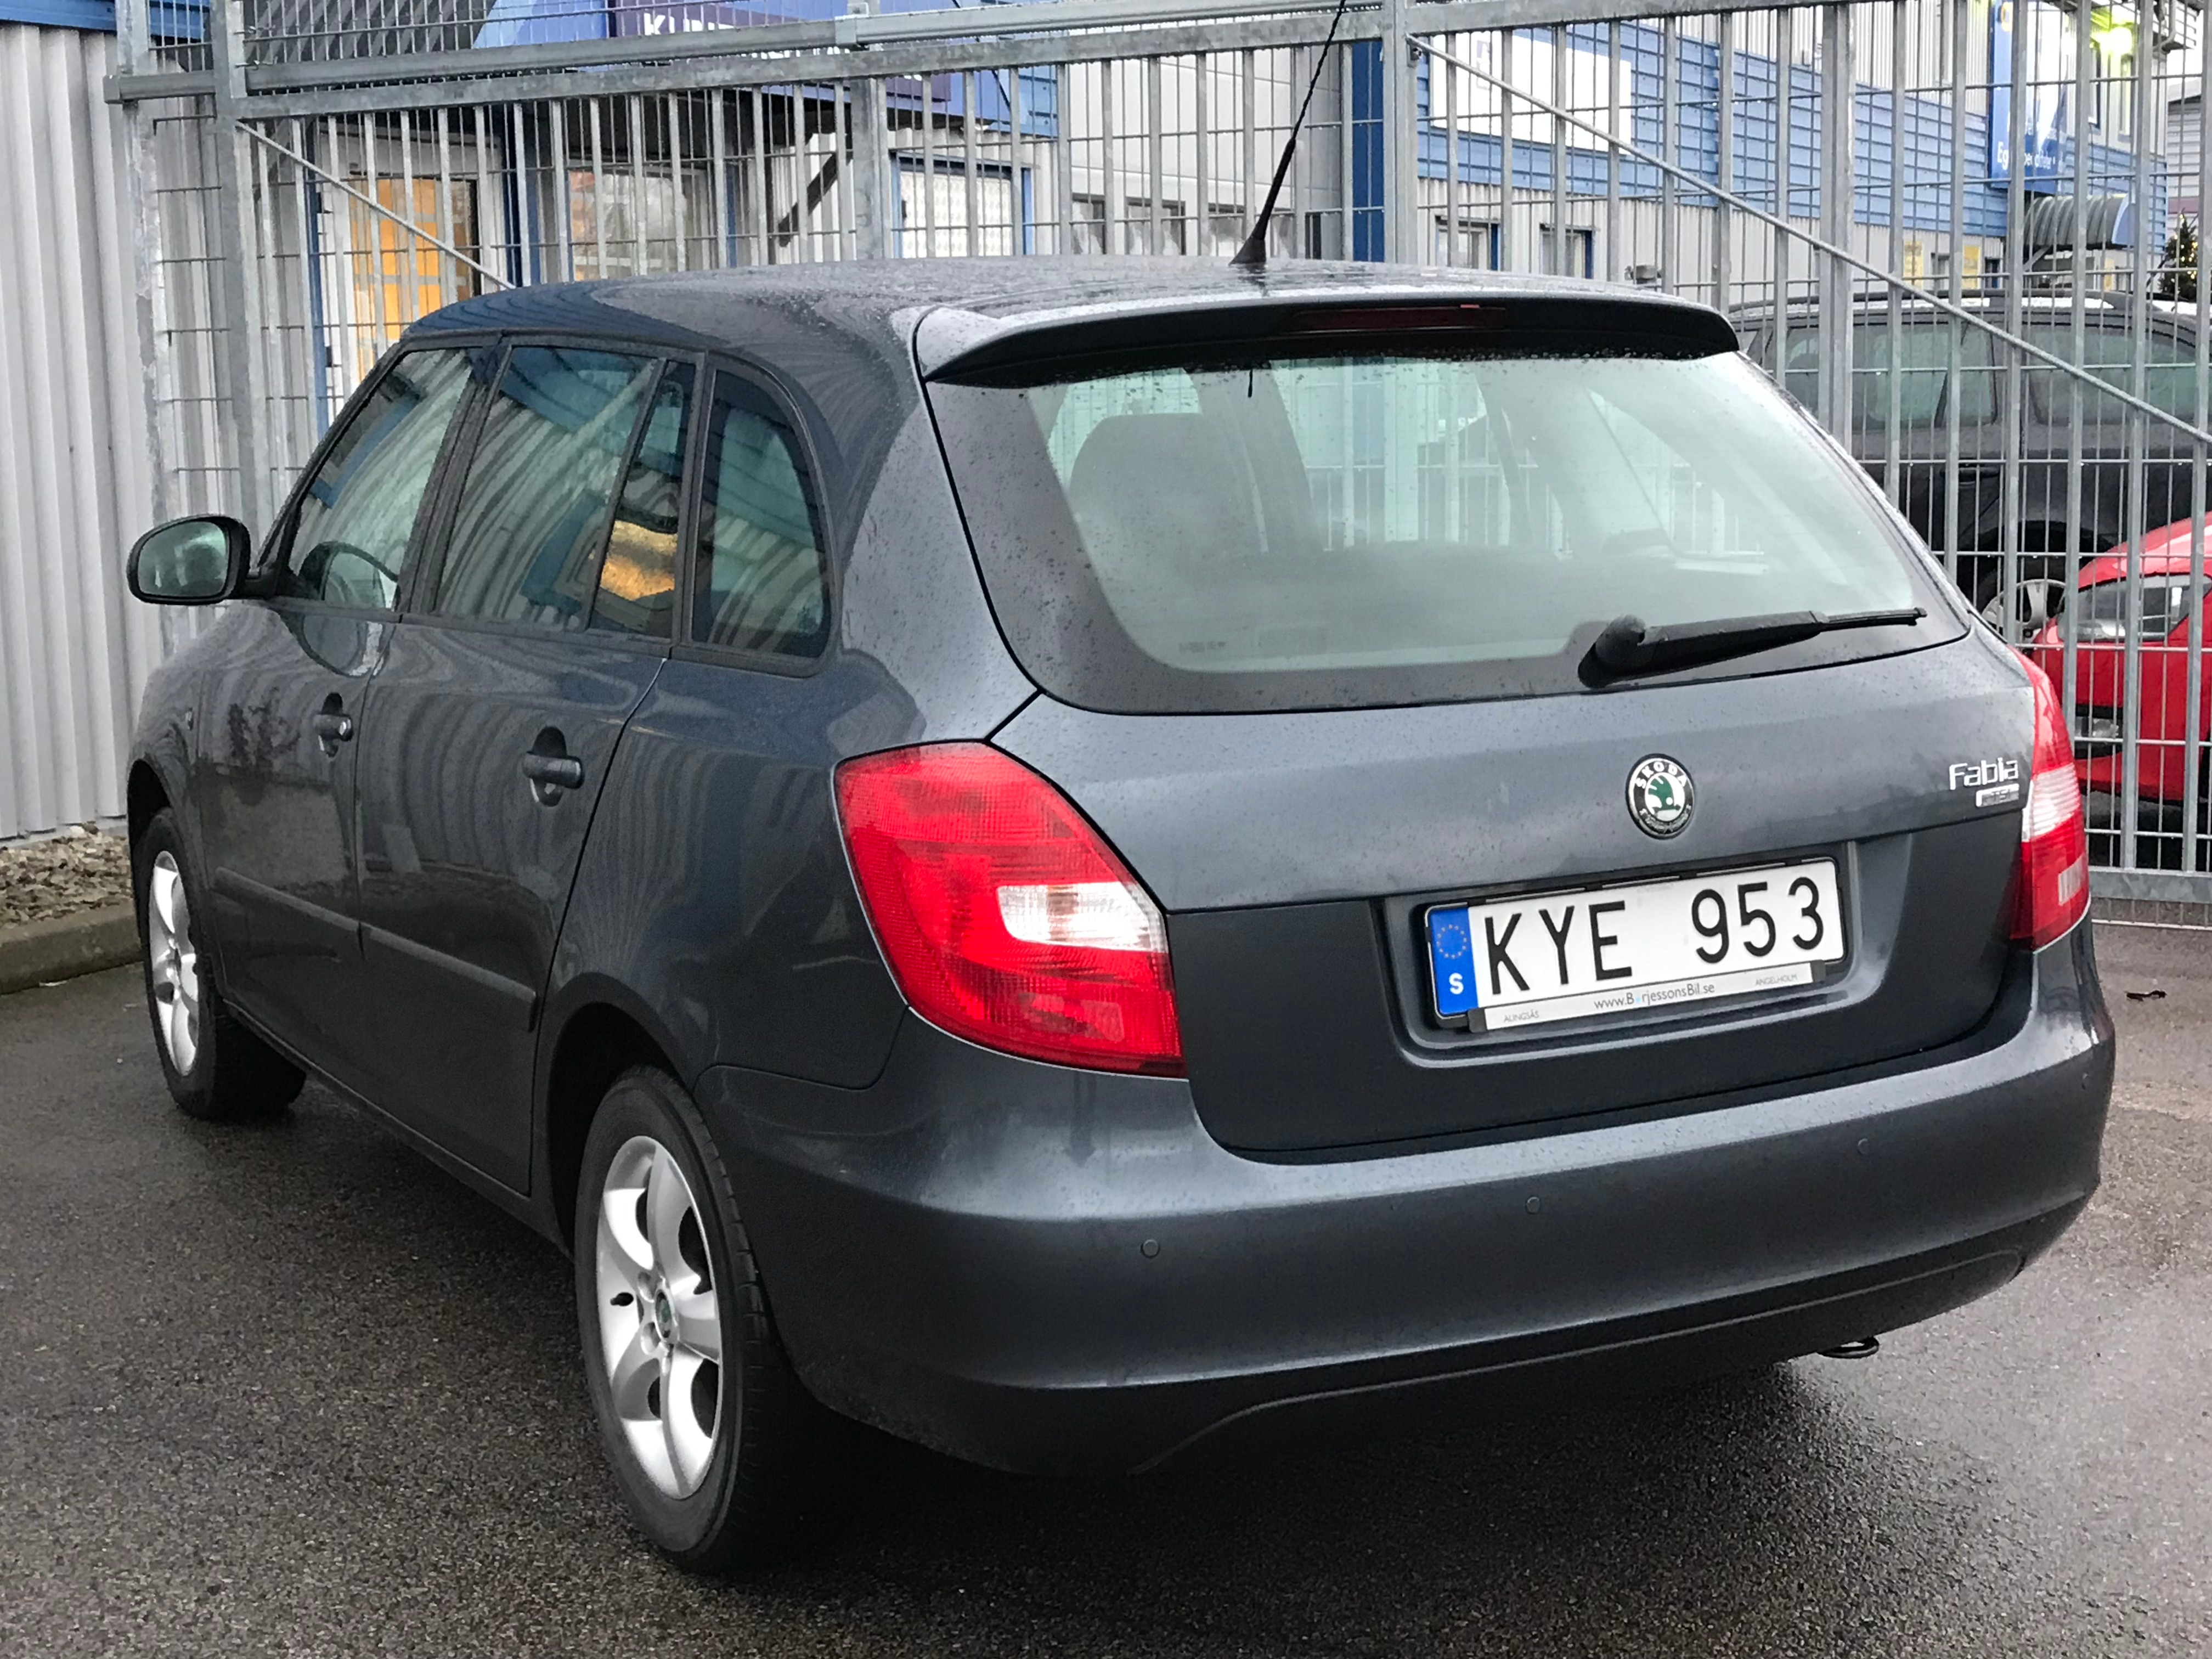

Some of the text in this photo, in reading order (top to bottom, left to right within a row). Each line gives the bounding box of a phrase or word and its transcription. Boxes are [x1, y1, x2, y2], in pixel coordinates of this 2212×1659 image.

[1949, 757, 2019, 790] Fabia
[1484, 877, 1824, 995] KYE 953
[1449, 973, 1464, 995] S
[1594, 983, 1715, 1009] www.BrjessonsBil.se
